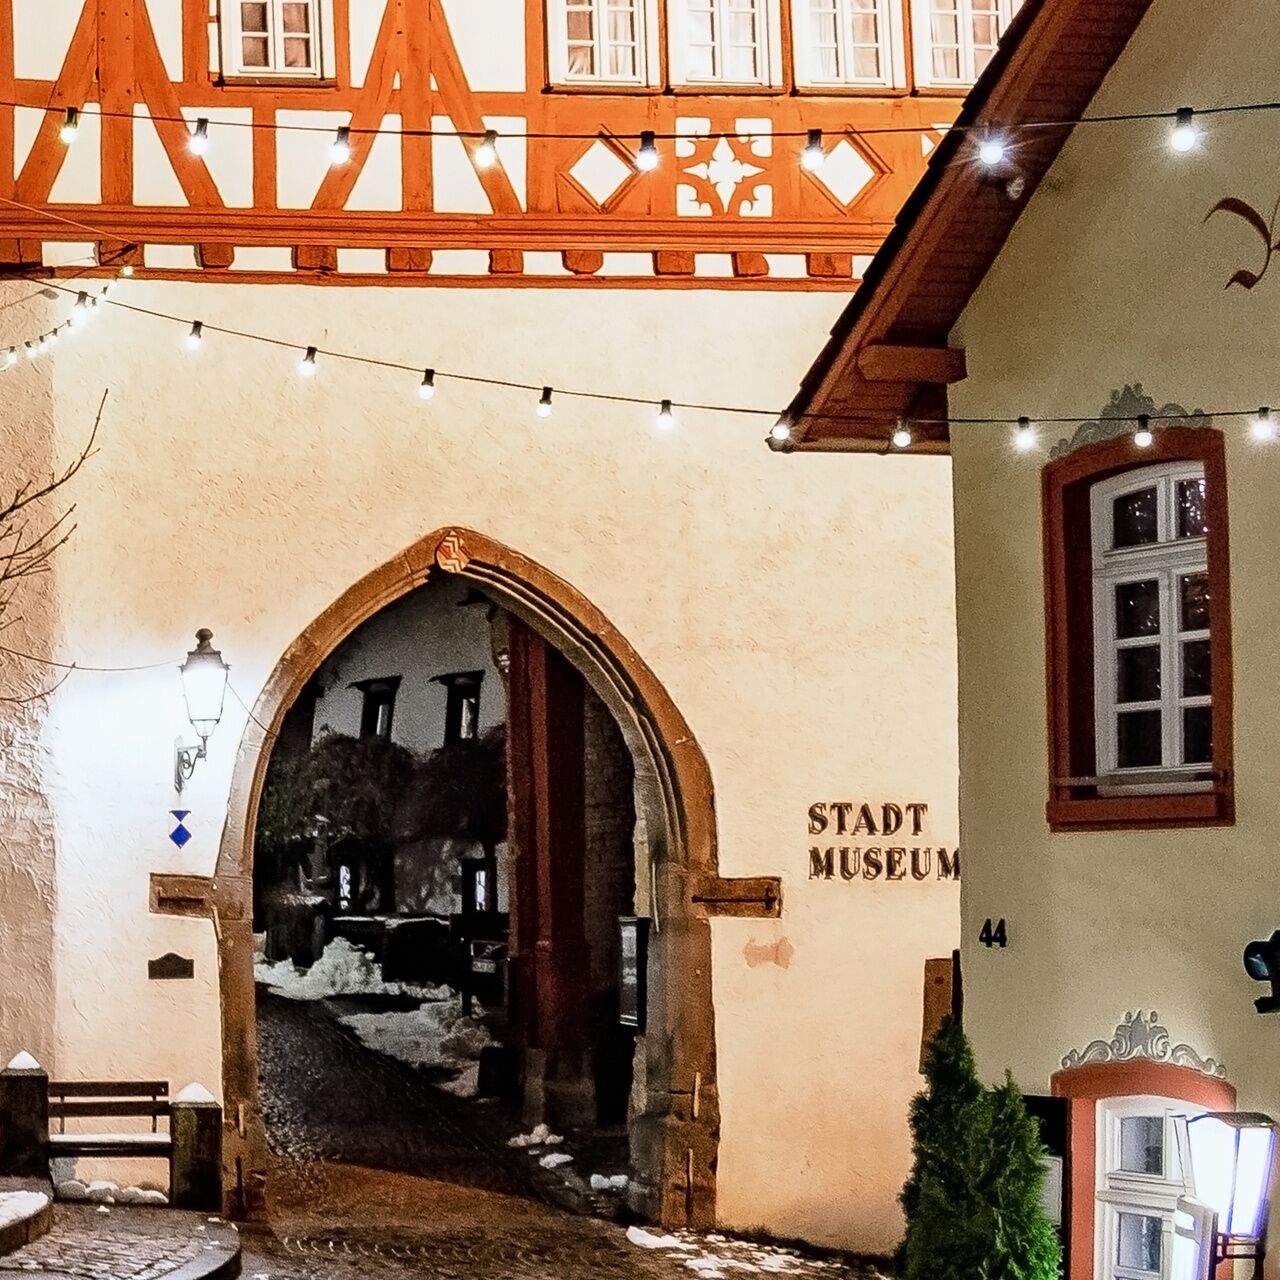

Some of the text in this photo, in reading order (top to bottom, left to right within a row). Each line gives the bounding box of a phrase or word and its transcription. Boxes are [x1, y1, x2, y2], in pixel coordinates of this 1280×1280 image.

[807, 802, 928, 836] STADT
[808, 846, 961, 881] MUSEUM
[978, 918, 1008, 948] 44
